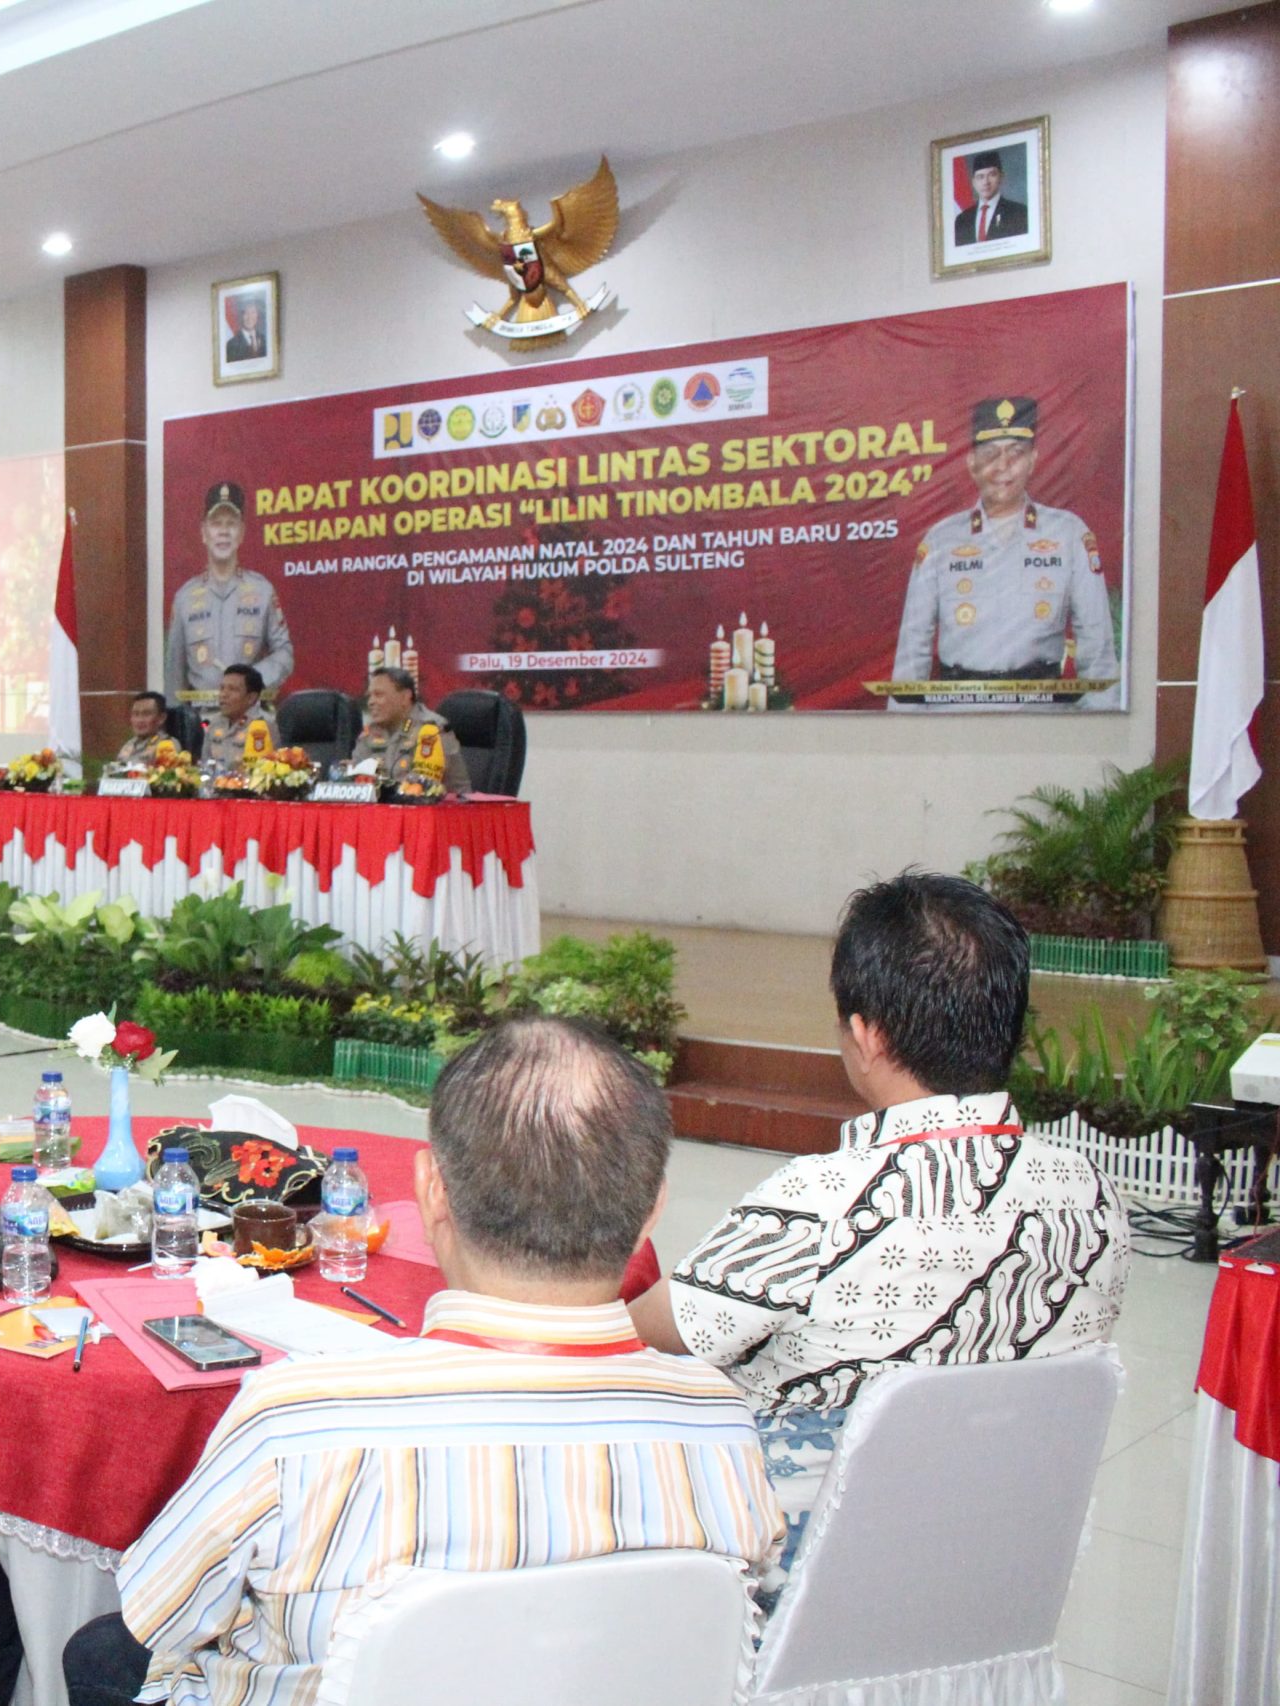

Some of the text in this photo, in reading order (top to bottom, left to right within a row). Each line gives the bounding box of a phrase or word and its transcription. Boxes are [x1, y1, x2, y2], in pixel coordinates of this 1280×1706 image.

[255, 420, 947, 516] RAPAT KOORDINASI LINTAS SEKTORAL
[263, 513, 387, 546] KESIAPAN
[394, 502, 512, 536] OPERASI
[616, 477, 817, 518] TINOMBALA
[284, 520, 899, 577] DALAM RANGKA PENGAMANAN NATAL 2024 DAN TAHUN BARU 2025
[1024, 557, 1062, 567] POLRI
[407, 550, 745, 587] DI WILAYAH HUKUM POLDA SULTENG
[949, 559, 983, 572] HELMI
[469, 652, 647, 670] Palu, 19 Desember 2024
[319, 784, 368, 800] KAROOPS
